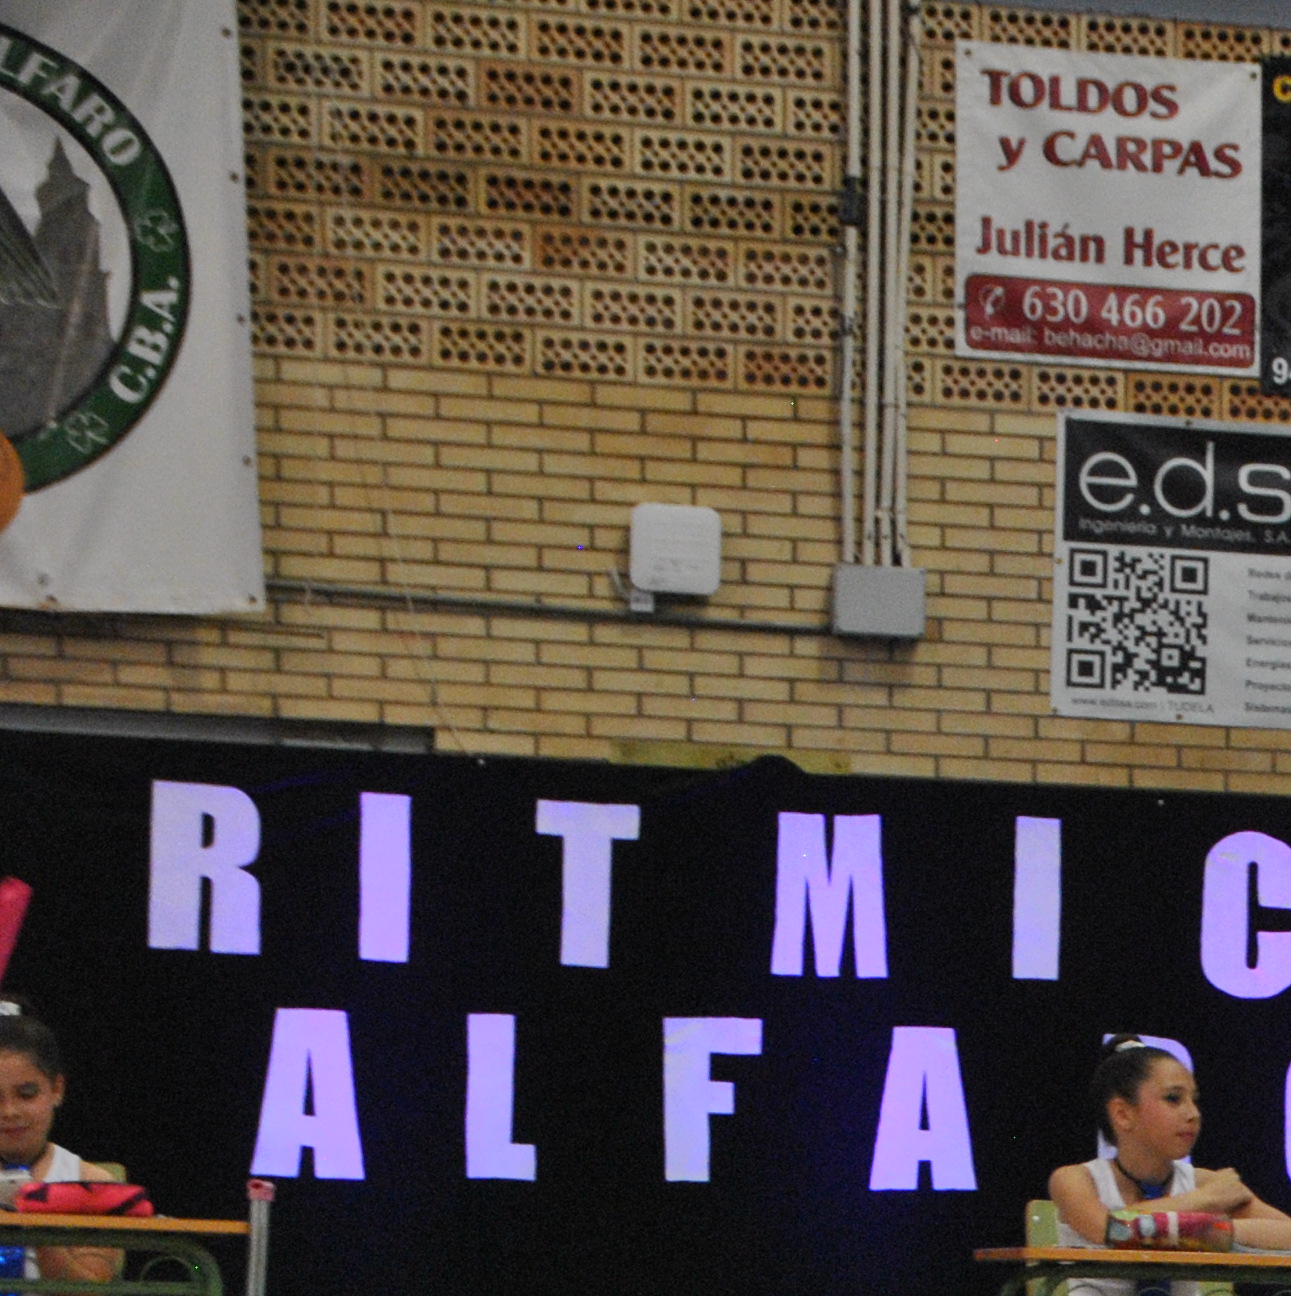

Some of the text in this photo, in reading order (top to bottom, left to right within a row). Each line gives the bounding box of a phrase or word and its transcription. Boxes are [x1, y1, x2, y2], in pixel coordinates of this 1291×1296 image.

[980, 67, 1180, 120] TOLDOS
[996, 130, 1243, 180] y CARPAS
[975, 215, 1247, 274] Julián Herce
[1022, 284, 1244, 336] 630 466 202
[109, 275, 181, 405] C.B.A.
